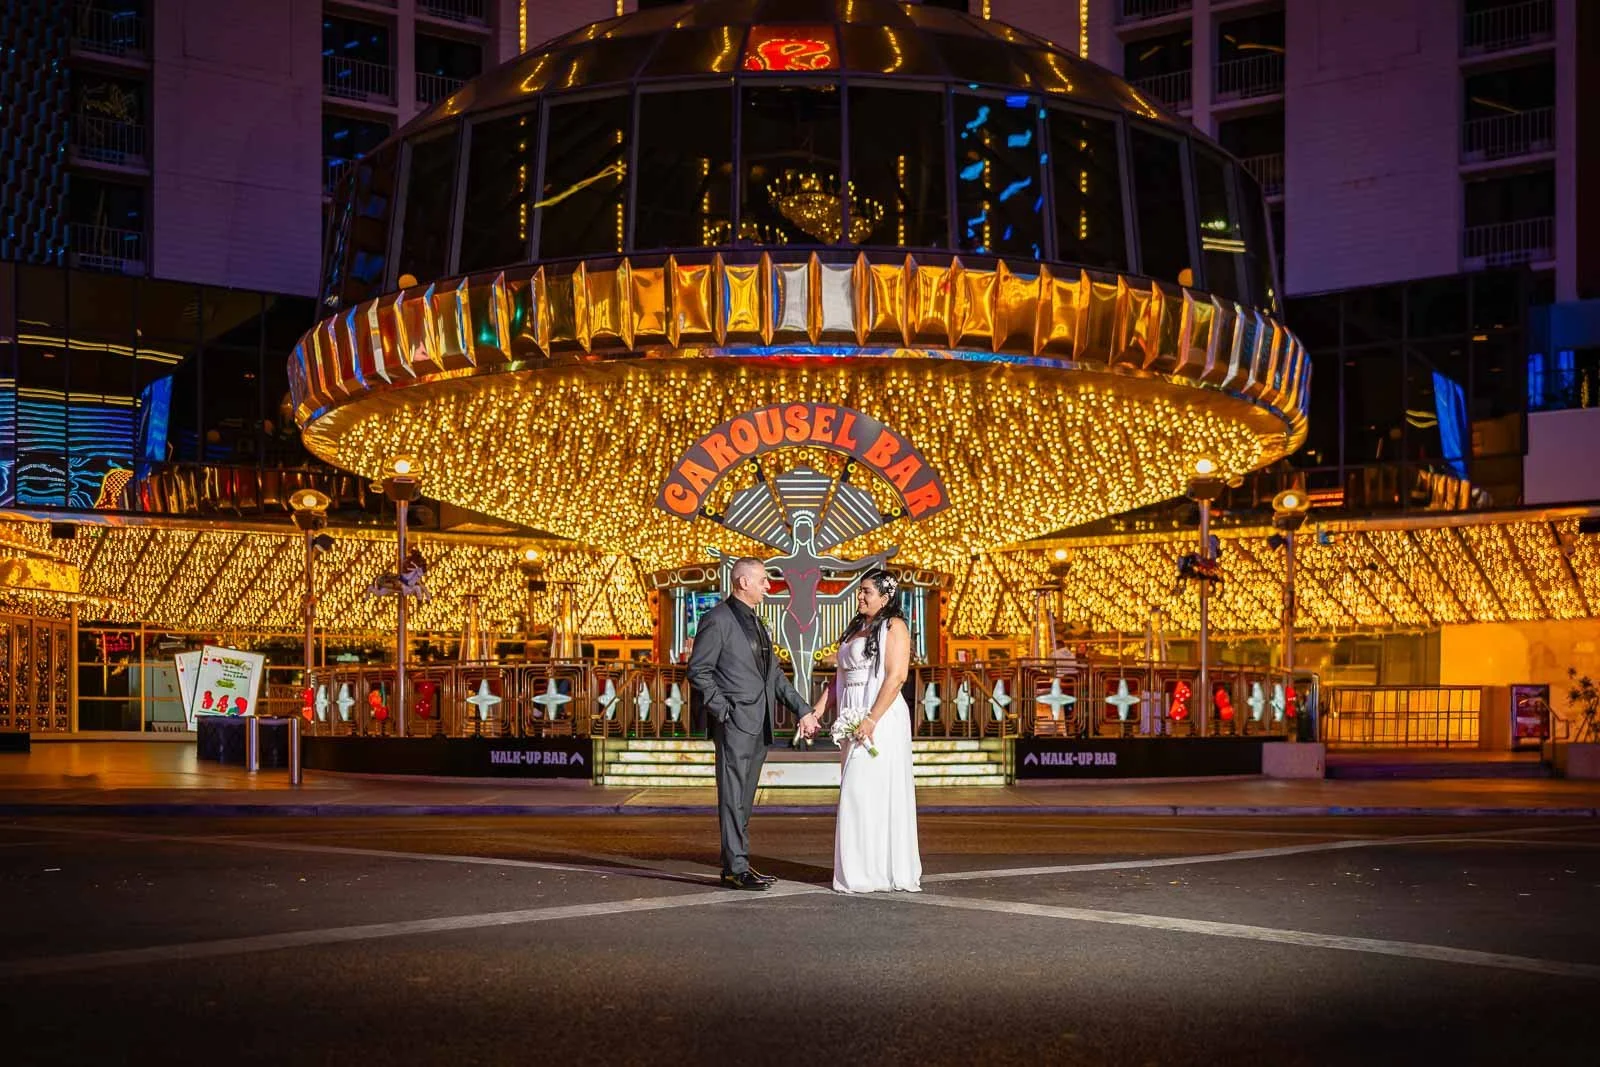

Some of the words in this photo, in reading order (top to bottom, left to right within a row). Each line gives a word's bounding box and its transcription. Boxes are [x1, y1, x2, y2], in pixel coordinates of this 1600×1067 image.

[664, 405, 856, 514] CAROUSEL
[863, 429, 942, 518] BAR
[490, 750, 541, 764] WALK-UP
[543, 751, 567, 764] BAR
[1040, 752, 1093, 765] WALK-UP
[1094, 752, 1117, 765] BAR
